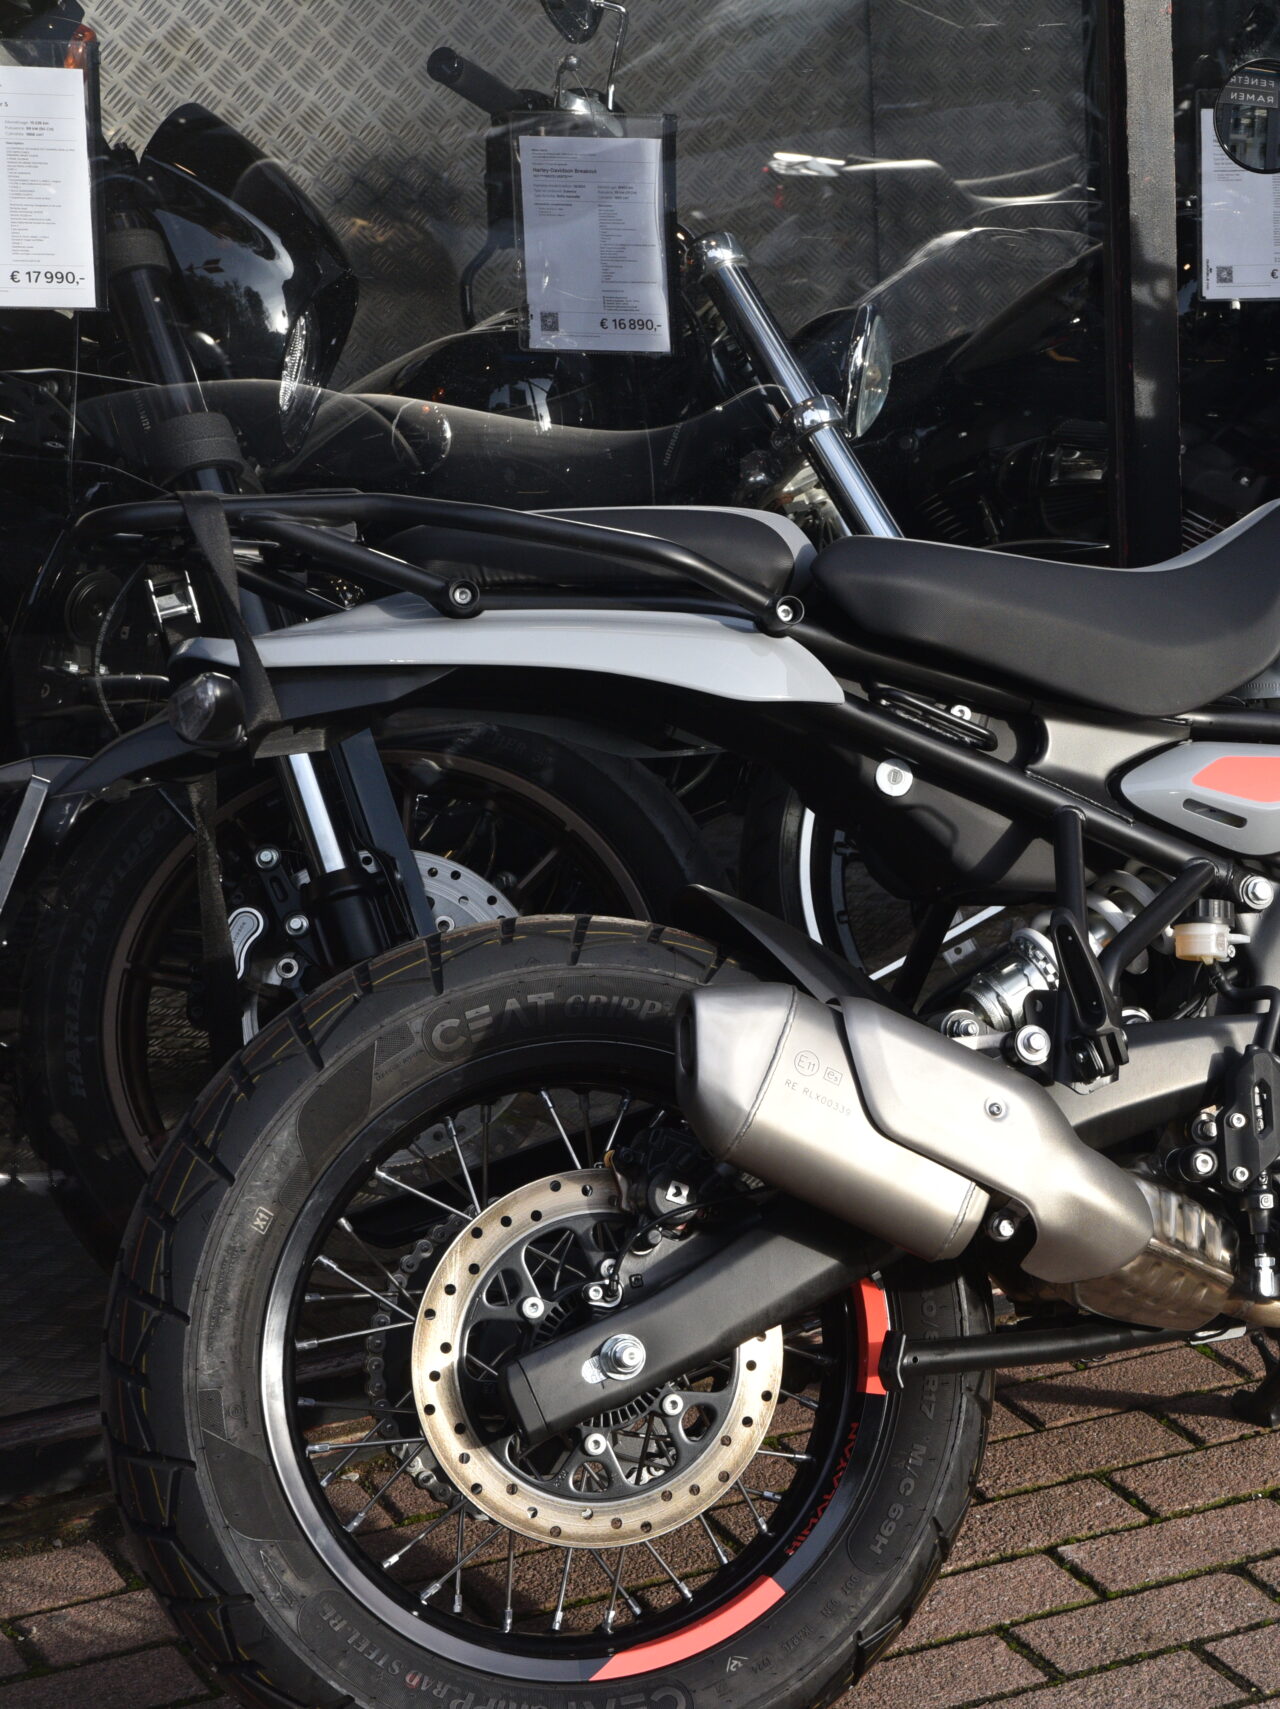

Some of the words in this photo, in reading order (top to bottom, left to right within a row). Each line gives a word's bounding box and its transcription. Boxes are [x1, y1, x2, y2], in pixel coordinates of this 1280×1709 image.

[10, 270, 21, 284] €
[1271, 269, 1279, 280] €
[600, 319, 609, 330] €
[431, 991, 555, 1051] CEAT
[784, 1422, 859, 1554] HIMALAYAN
[897, 1444, 927, 1497] M/C
[868, 1502, 903, 1555] 69H
[346, 1627, 402, 1676] STEEL
